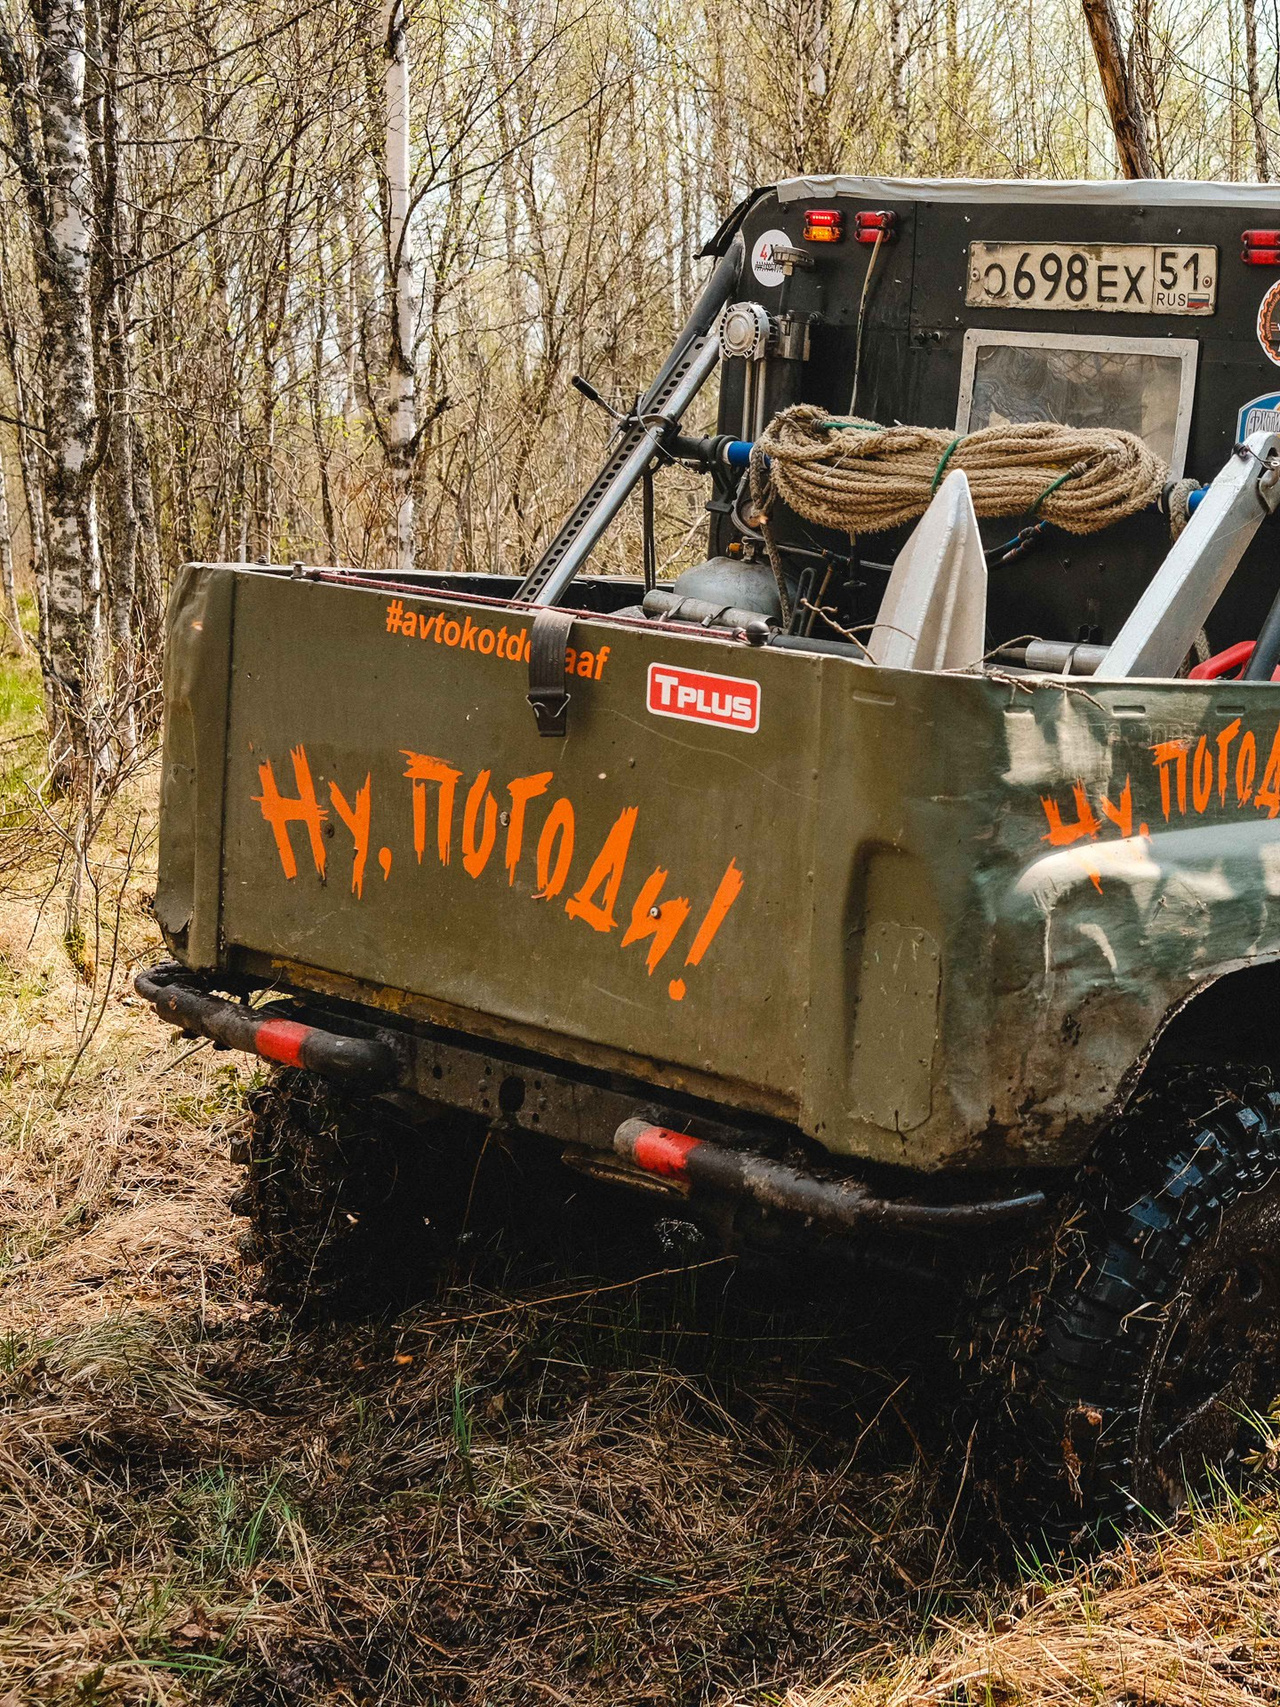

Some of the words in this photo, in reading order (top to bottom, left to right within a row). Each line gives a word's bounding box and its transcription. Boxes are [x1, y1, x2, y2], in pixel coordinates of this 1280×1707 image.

[1159, 252, 1200, 290] 51
[1156, 292, 1187, 307] RUS
[386, 599, 611, 681] #avtokotdaaf
